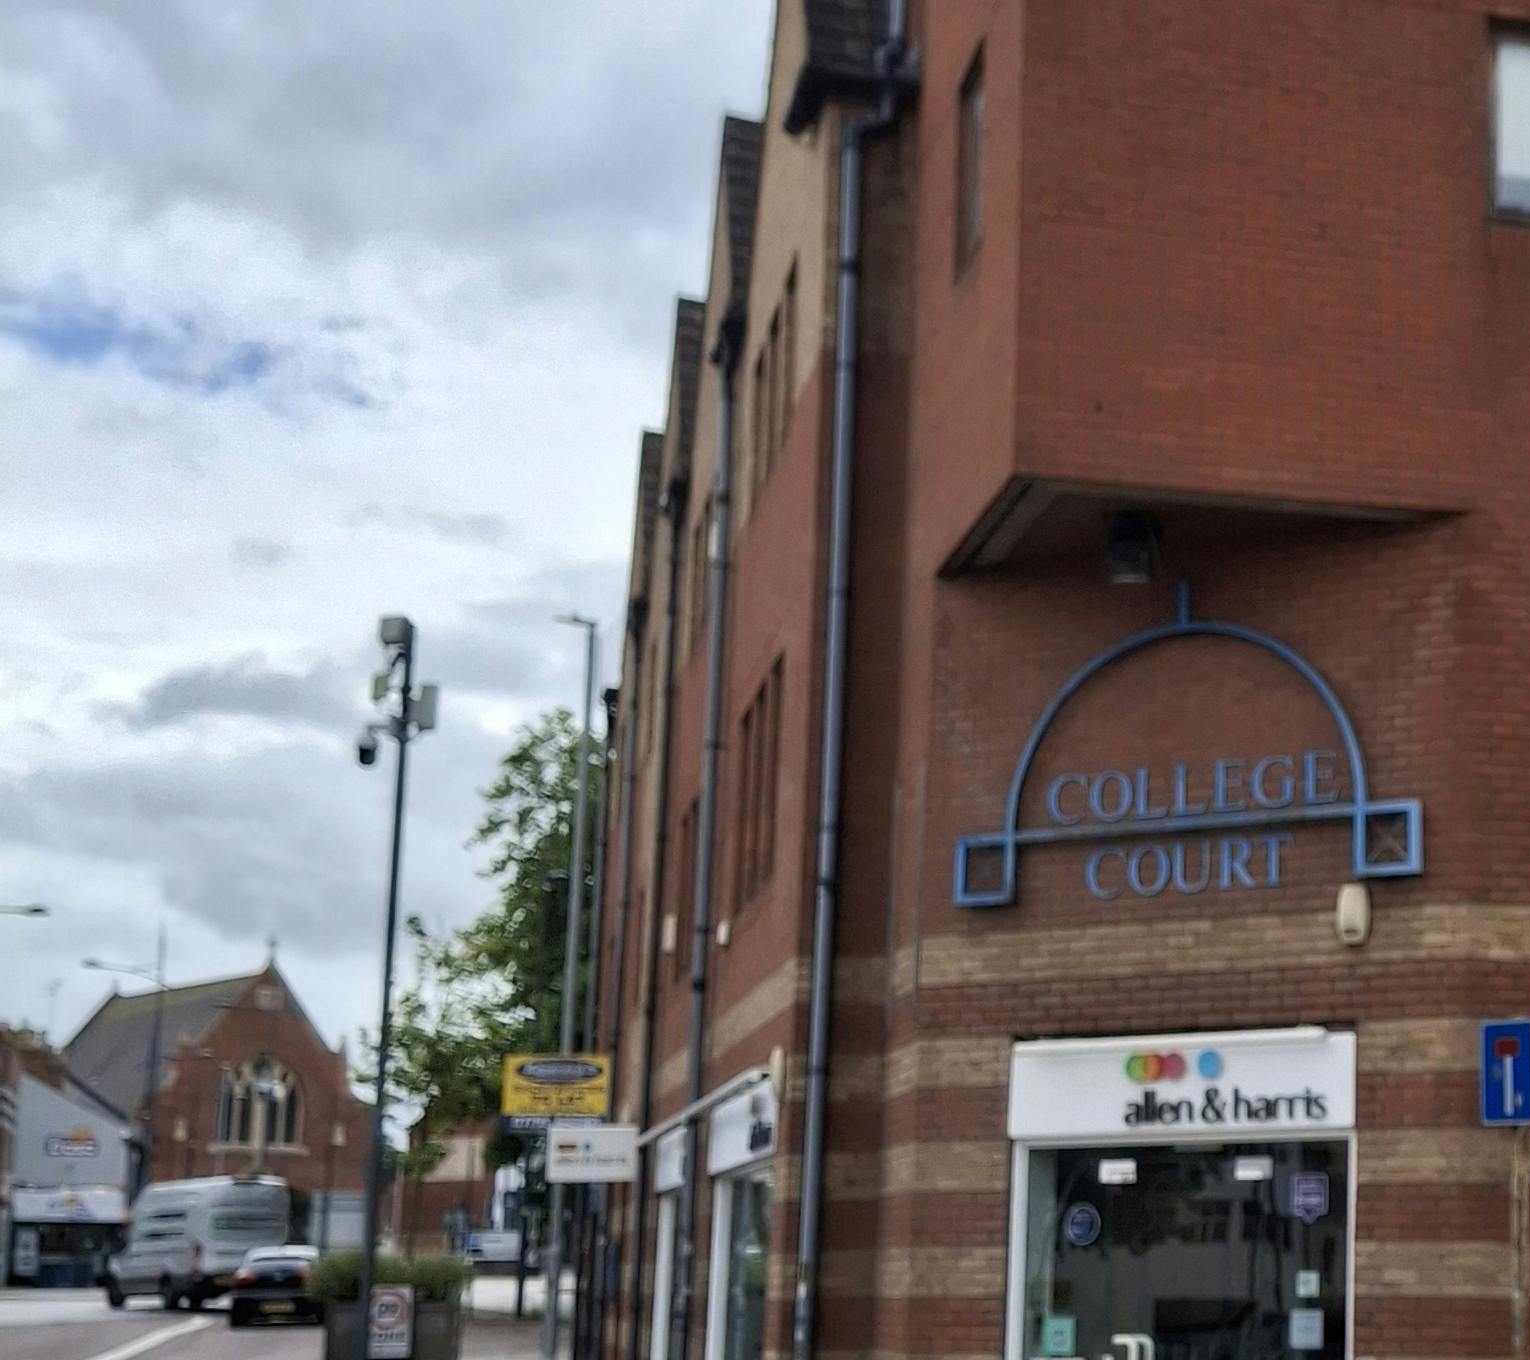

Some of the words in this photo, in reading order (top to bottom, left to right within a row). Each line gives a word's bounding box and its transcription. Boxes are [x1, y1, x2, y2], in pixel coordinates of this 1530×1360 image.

[1045, 749, 1341, 827] COLLEGE
[1084, 832, 1294, 901] COURT
[1124, 1088, 1195, 1126] allen
[1201, 1087, 1226, 1123] &
[1231, 1086, 1328, 1121] harris
